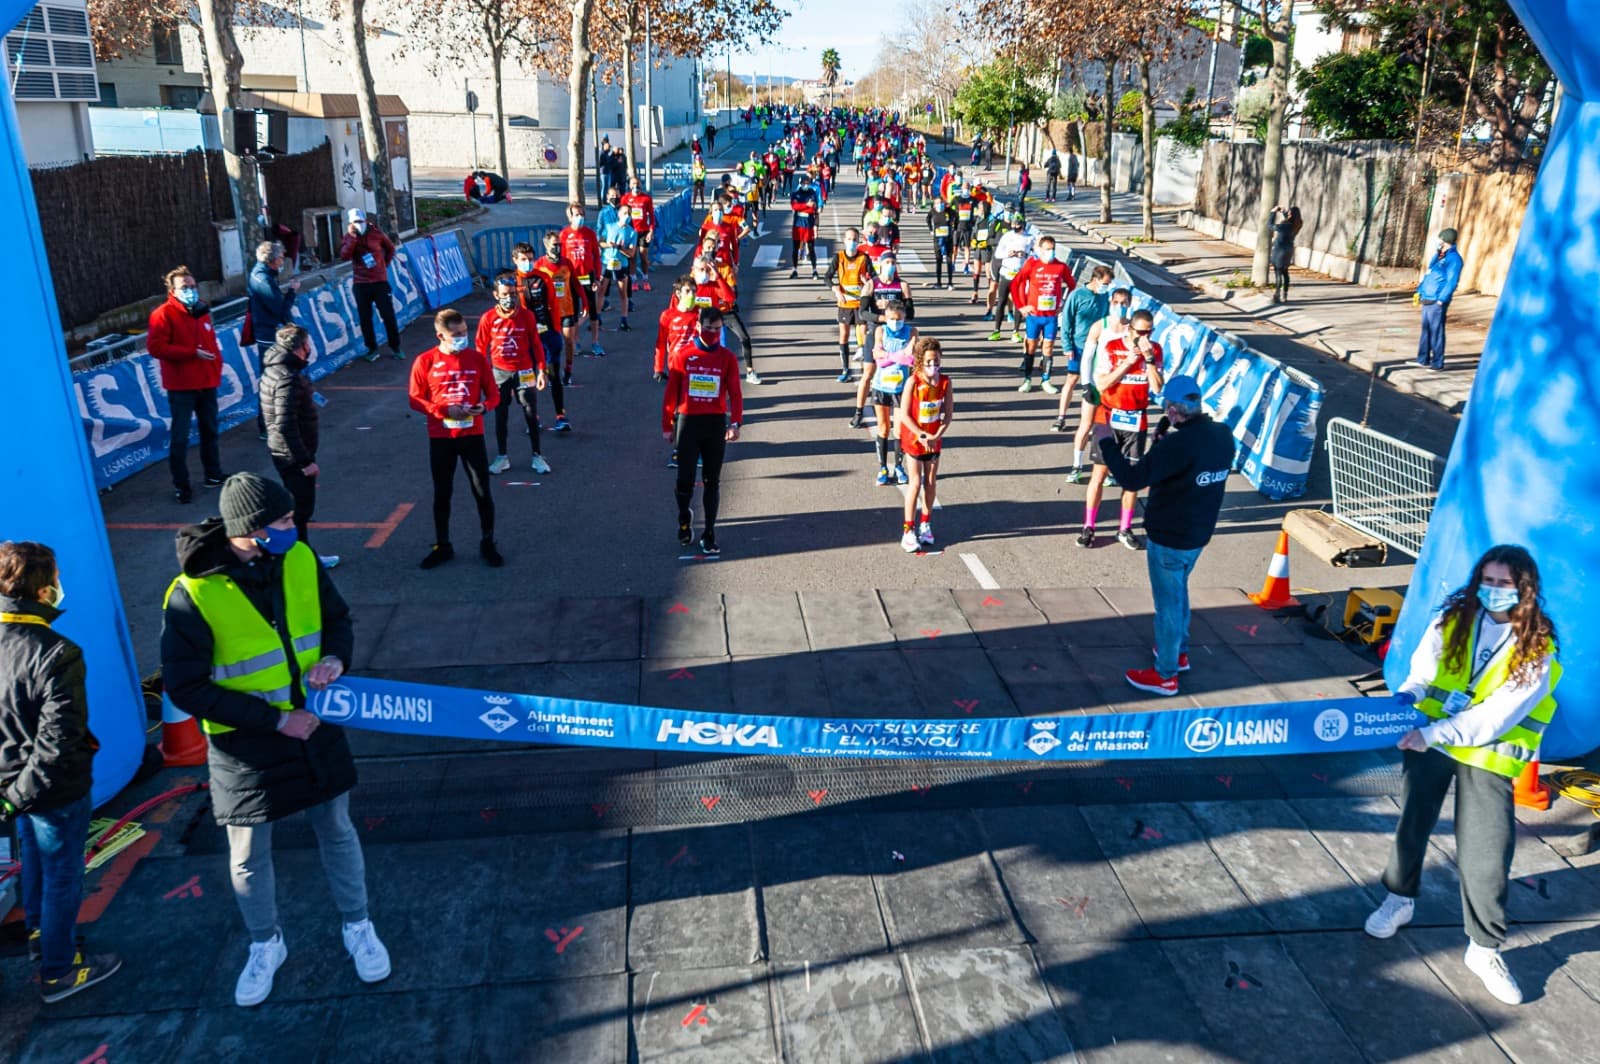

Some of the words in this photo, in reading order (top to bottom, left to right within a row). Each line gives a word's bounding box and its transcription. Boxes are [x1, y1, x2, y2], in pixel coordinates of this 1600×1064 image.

[361, 691, 433, 723] LASANSI
[527, 710, 615, 727] Ajuntament
[1353, 709, 1418, 725] Diputació
[527, 722, 550, 733] del
[556, 724, 615, 738] Masnou
[656, 718, 778, 749] HOKA
[821, 722, 880, 735] SANT
[882, 722, 982, 736] SILVESTRE
[1224, 717, 1290, 747] LASANSI
[839, 735, 861, 746] EL
[865, 735, 960, 748] MASNOU
[1066, 741, 1090, 752] del
[1094, 740, 1149, 752] Masnou
[800, 746, 831, 755] Gran
[833, 747, 872, 757] premi
